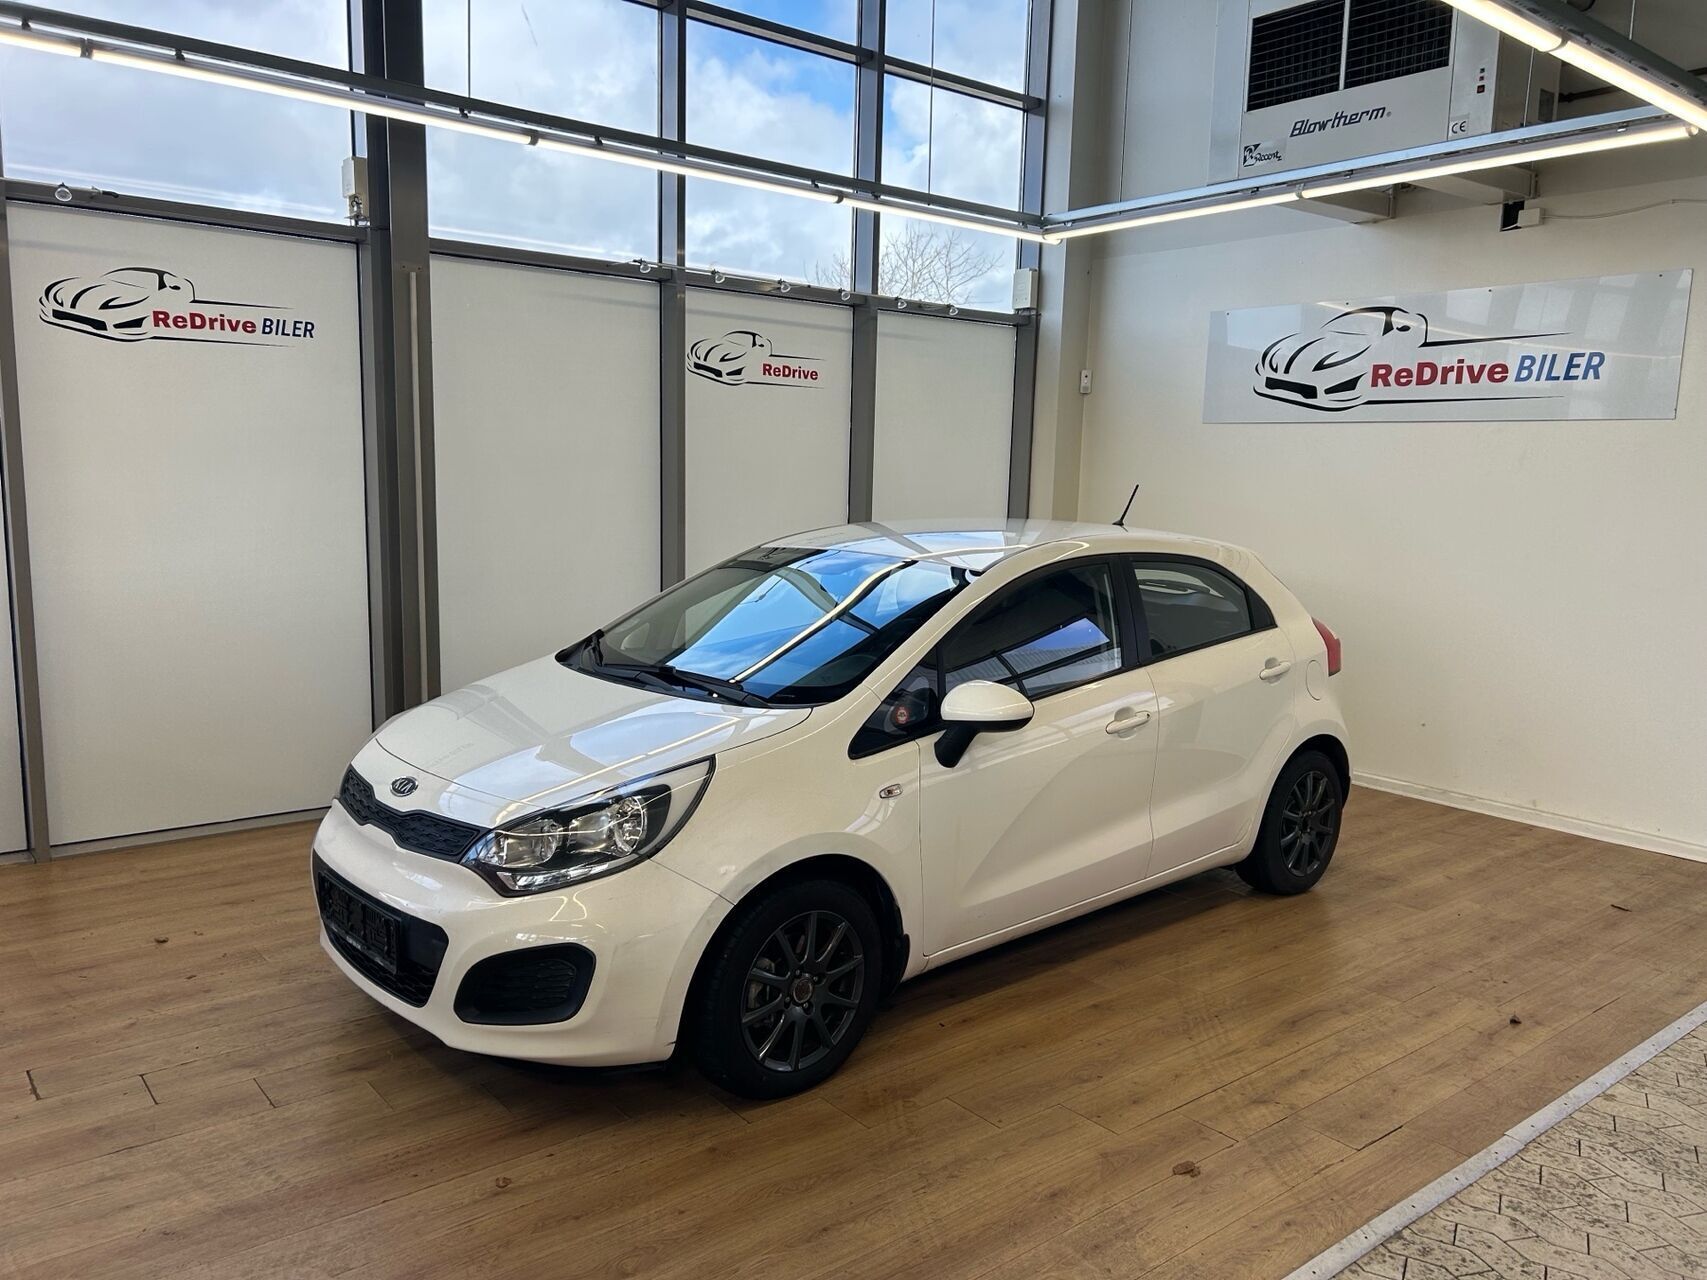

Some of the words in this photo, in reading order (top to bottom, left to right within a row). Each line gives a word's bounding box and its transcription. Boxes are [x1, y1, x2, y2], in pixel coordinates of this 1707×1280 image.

[1451, 120, 1467, 134] CE
[152, 310, 257, 334] ReDrive
[261, 317, 315, 339] BILER
[762, 362, 819, 381] ReDrive
[1370, 358, 1509, 388] ReDrive
[1514, 351, 1605, 383] BILER
[393, 779, 415, 794] KIA
